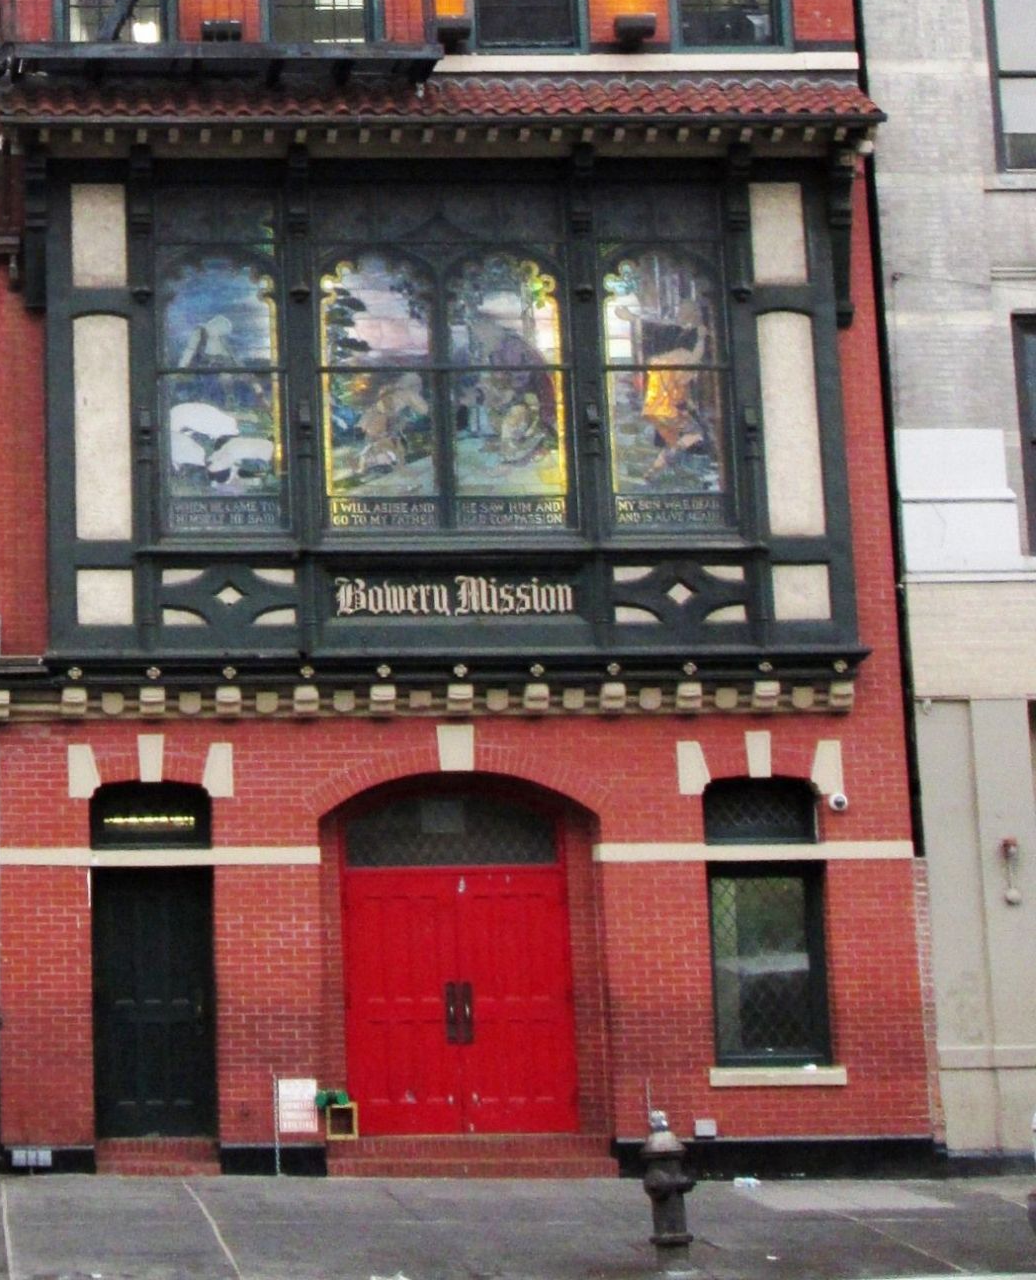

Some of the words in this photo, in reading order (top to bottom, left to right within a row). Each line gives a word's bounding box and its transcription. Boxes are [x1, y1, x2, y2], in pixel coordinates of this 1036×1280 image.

[340, 502, 371, 514] WILL
[411, 502, 435, 514] AND
[535, 502, 562, 513] AND
[333, 514, 349, 526] GO
[350, 514, 368, 526] TO
[335, 577, 450, 617] Bowery
[454, 575, 574, 616] Mission
